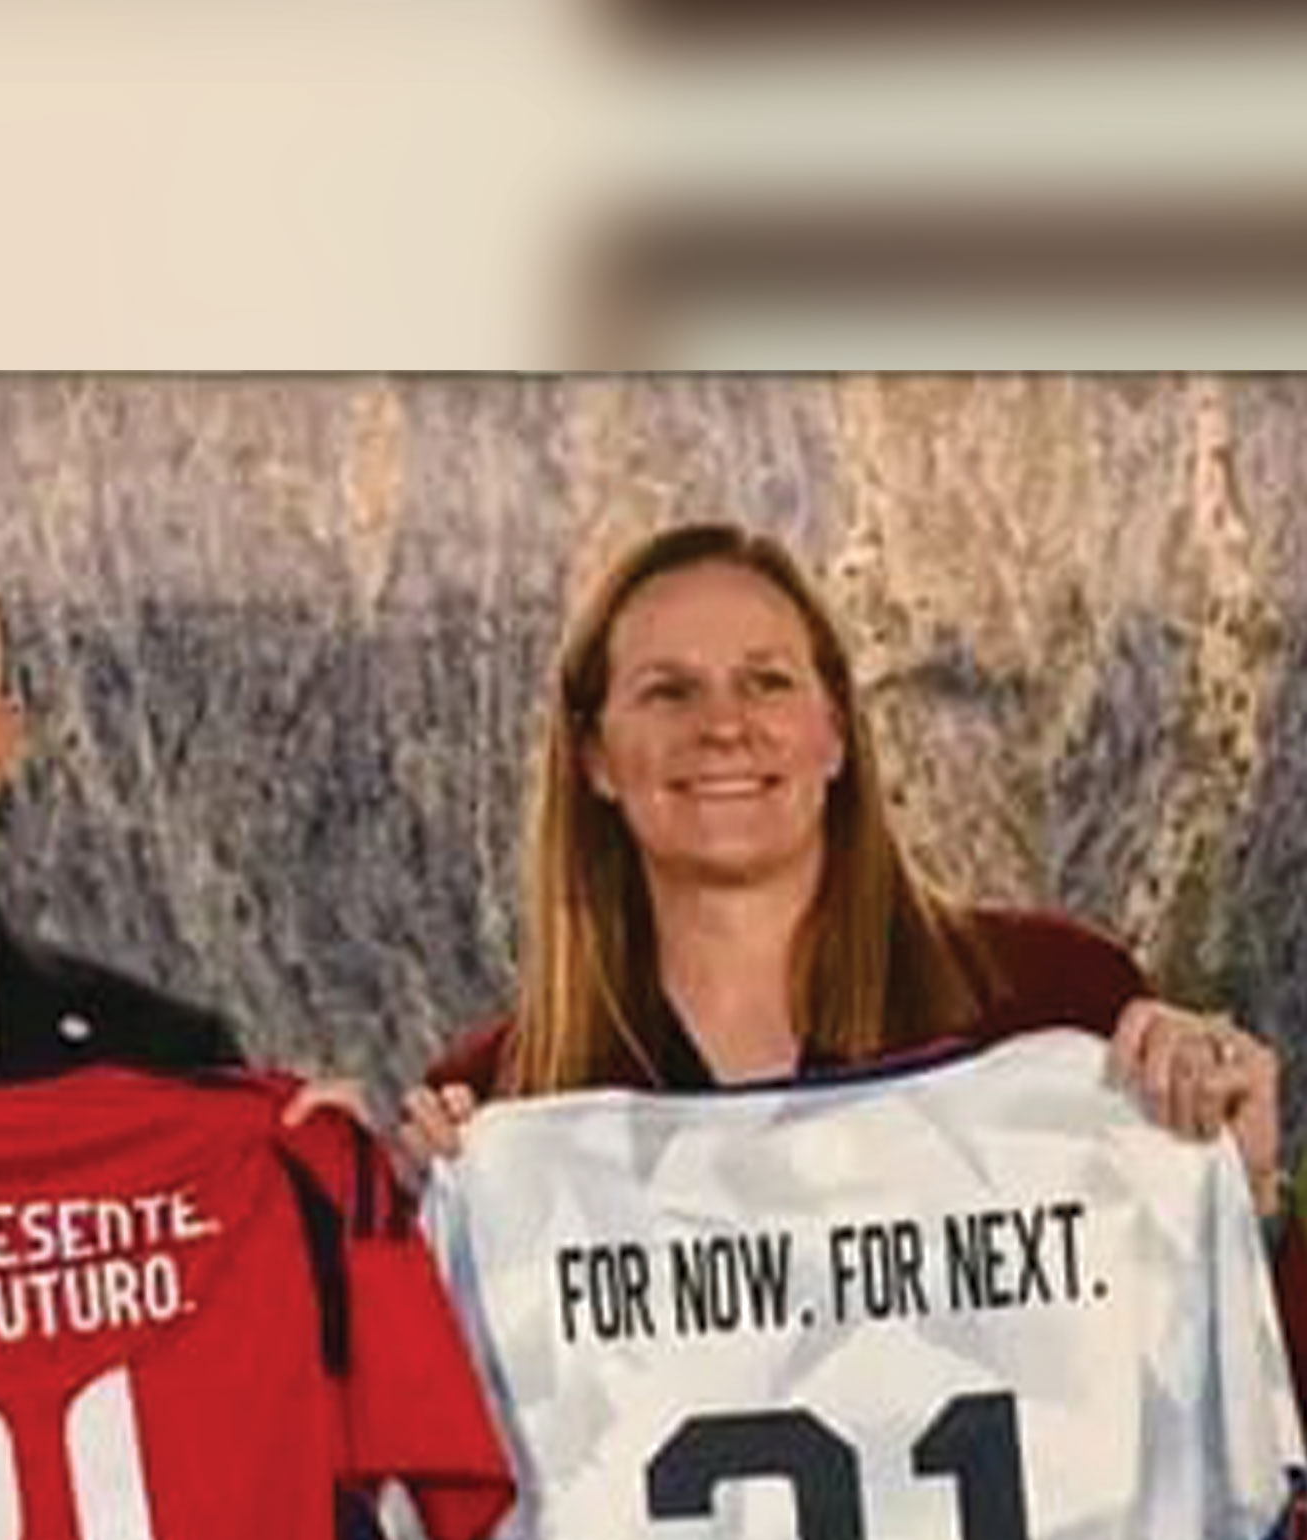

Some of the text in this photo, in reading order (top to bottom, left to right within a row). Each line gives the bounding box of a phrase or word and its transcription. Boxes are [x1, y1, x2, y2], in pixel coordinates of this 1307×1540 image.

[558, 1203, 1109, 1341] FOR NOW. FOR NEXT.
